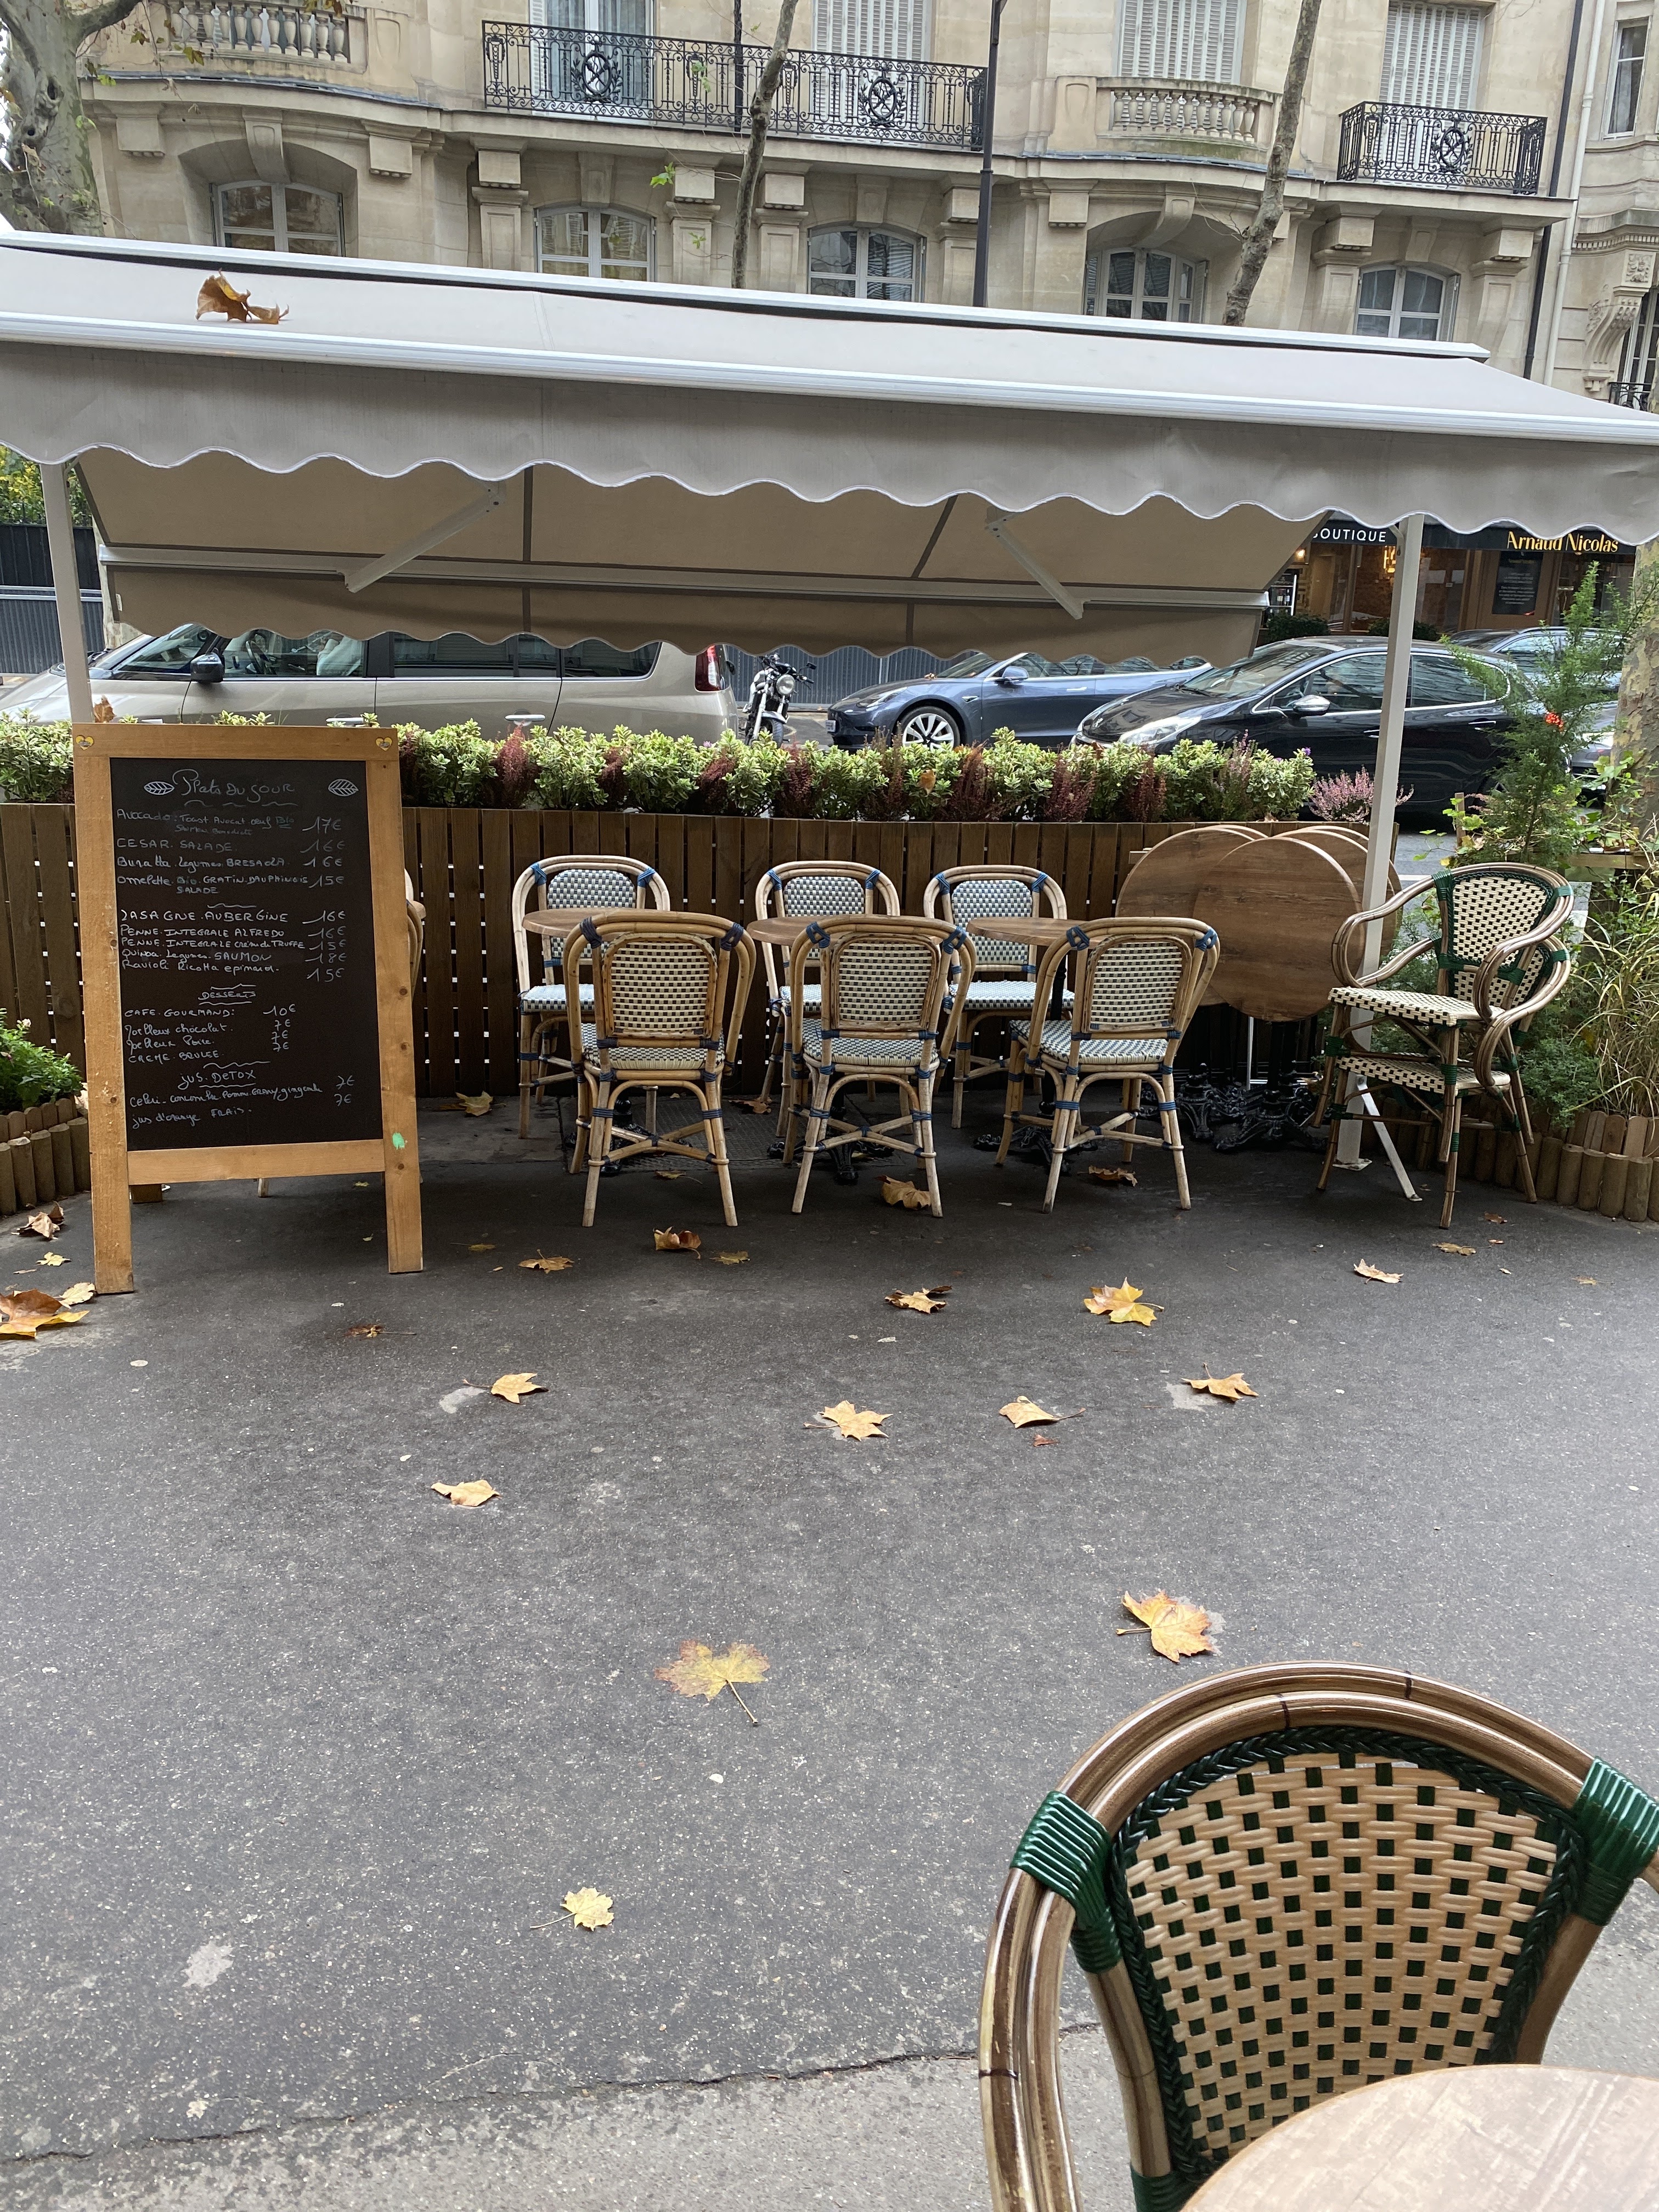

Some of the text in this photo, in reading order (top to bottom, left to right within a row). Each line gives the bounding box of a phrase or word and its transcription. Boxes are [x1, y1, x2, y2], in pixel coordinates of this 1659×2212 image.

[1507, 531, 1619, 552] Arnaud Nicolas
[176, 886, 218, 894] SALADE
[302, 910, 346, 924] 16€
[234, 928, 284, 938] ALFREDO
[308, 926, 346, 939] 16€
[271, 940, 306, 949] TRUFFE
[309, 939, 346, 951] 15€
[214, 952, 271, 962] SAUMON
[305, 952, 347, 964] 18€
[307, 967, 345, 983] 15€
[263, 1003, 296, 1017] 10€
[274, 1019, 291, 1031] 7€
[271, 1030, 288, 1043] 7€
[272, 1042, 290, 1052] 7€
[335, 1075, 355, 1090] 7€
[334, 1093, 352, 1107] 7€
